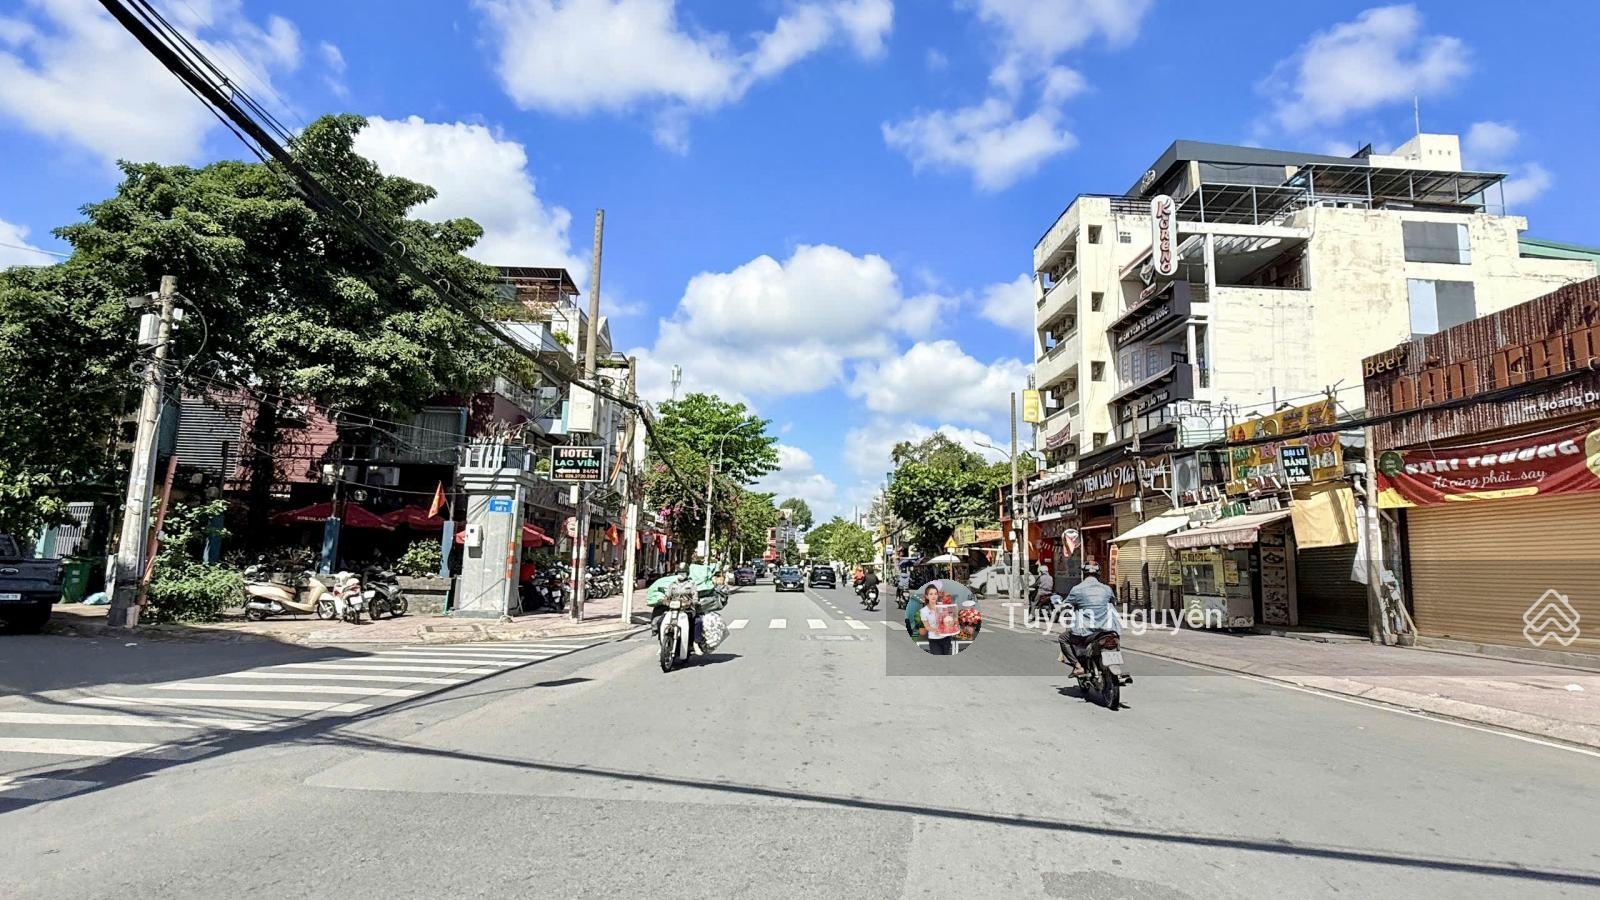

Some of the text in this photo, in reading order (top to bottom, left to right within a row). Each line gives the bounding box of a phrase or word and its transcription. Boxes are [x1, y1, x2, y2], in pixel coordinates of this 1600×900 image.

[1364, 353, 1406, 378] Beer
[560, 449, 595, 458] HOTEL
[555, 458, 599, 468] LẠC VIÊN
[1290, 466, 1305, 476] PÍA
